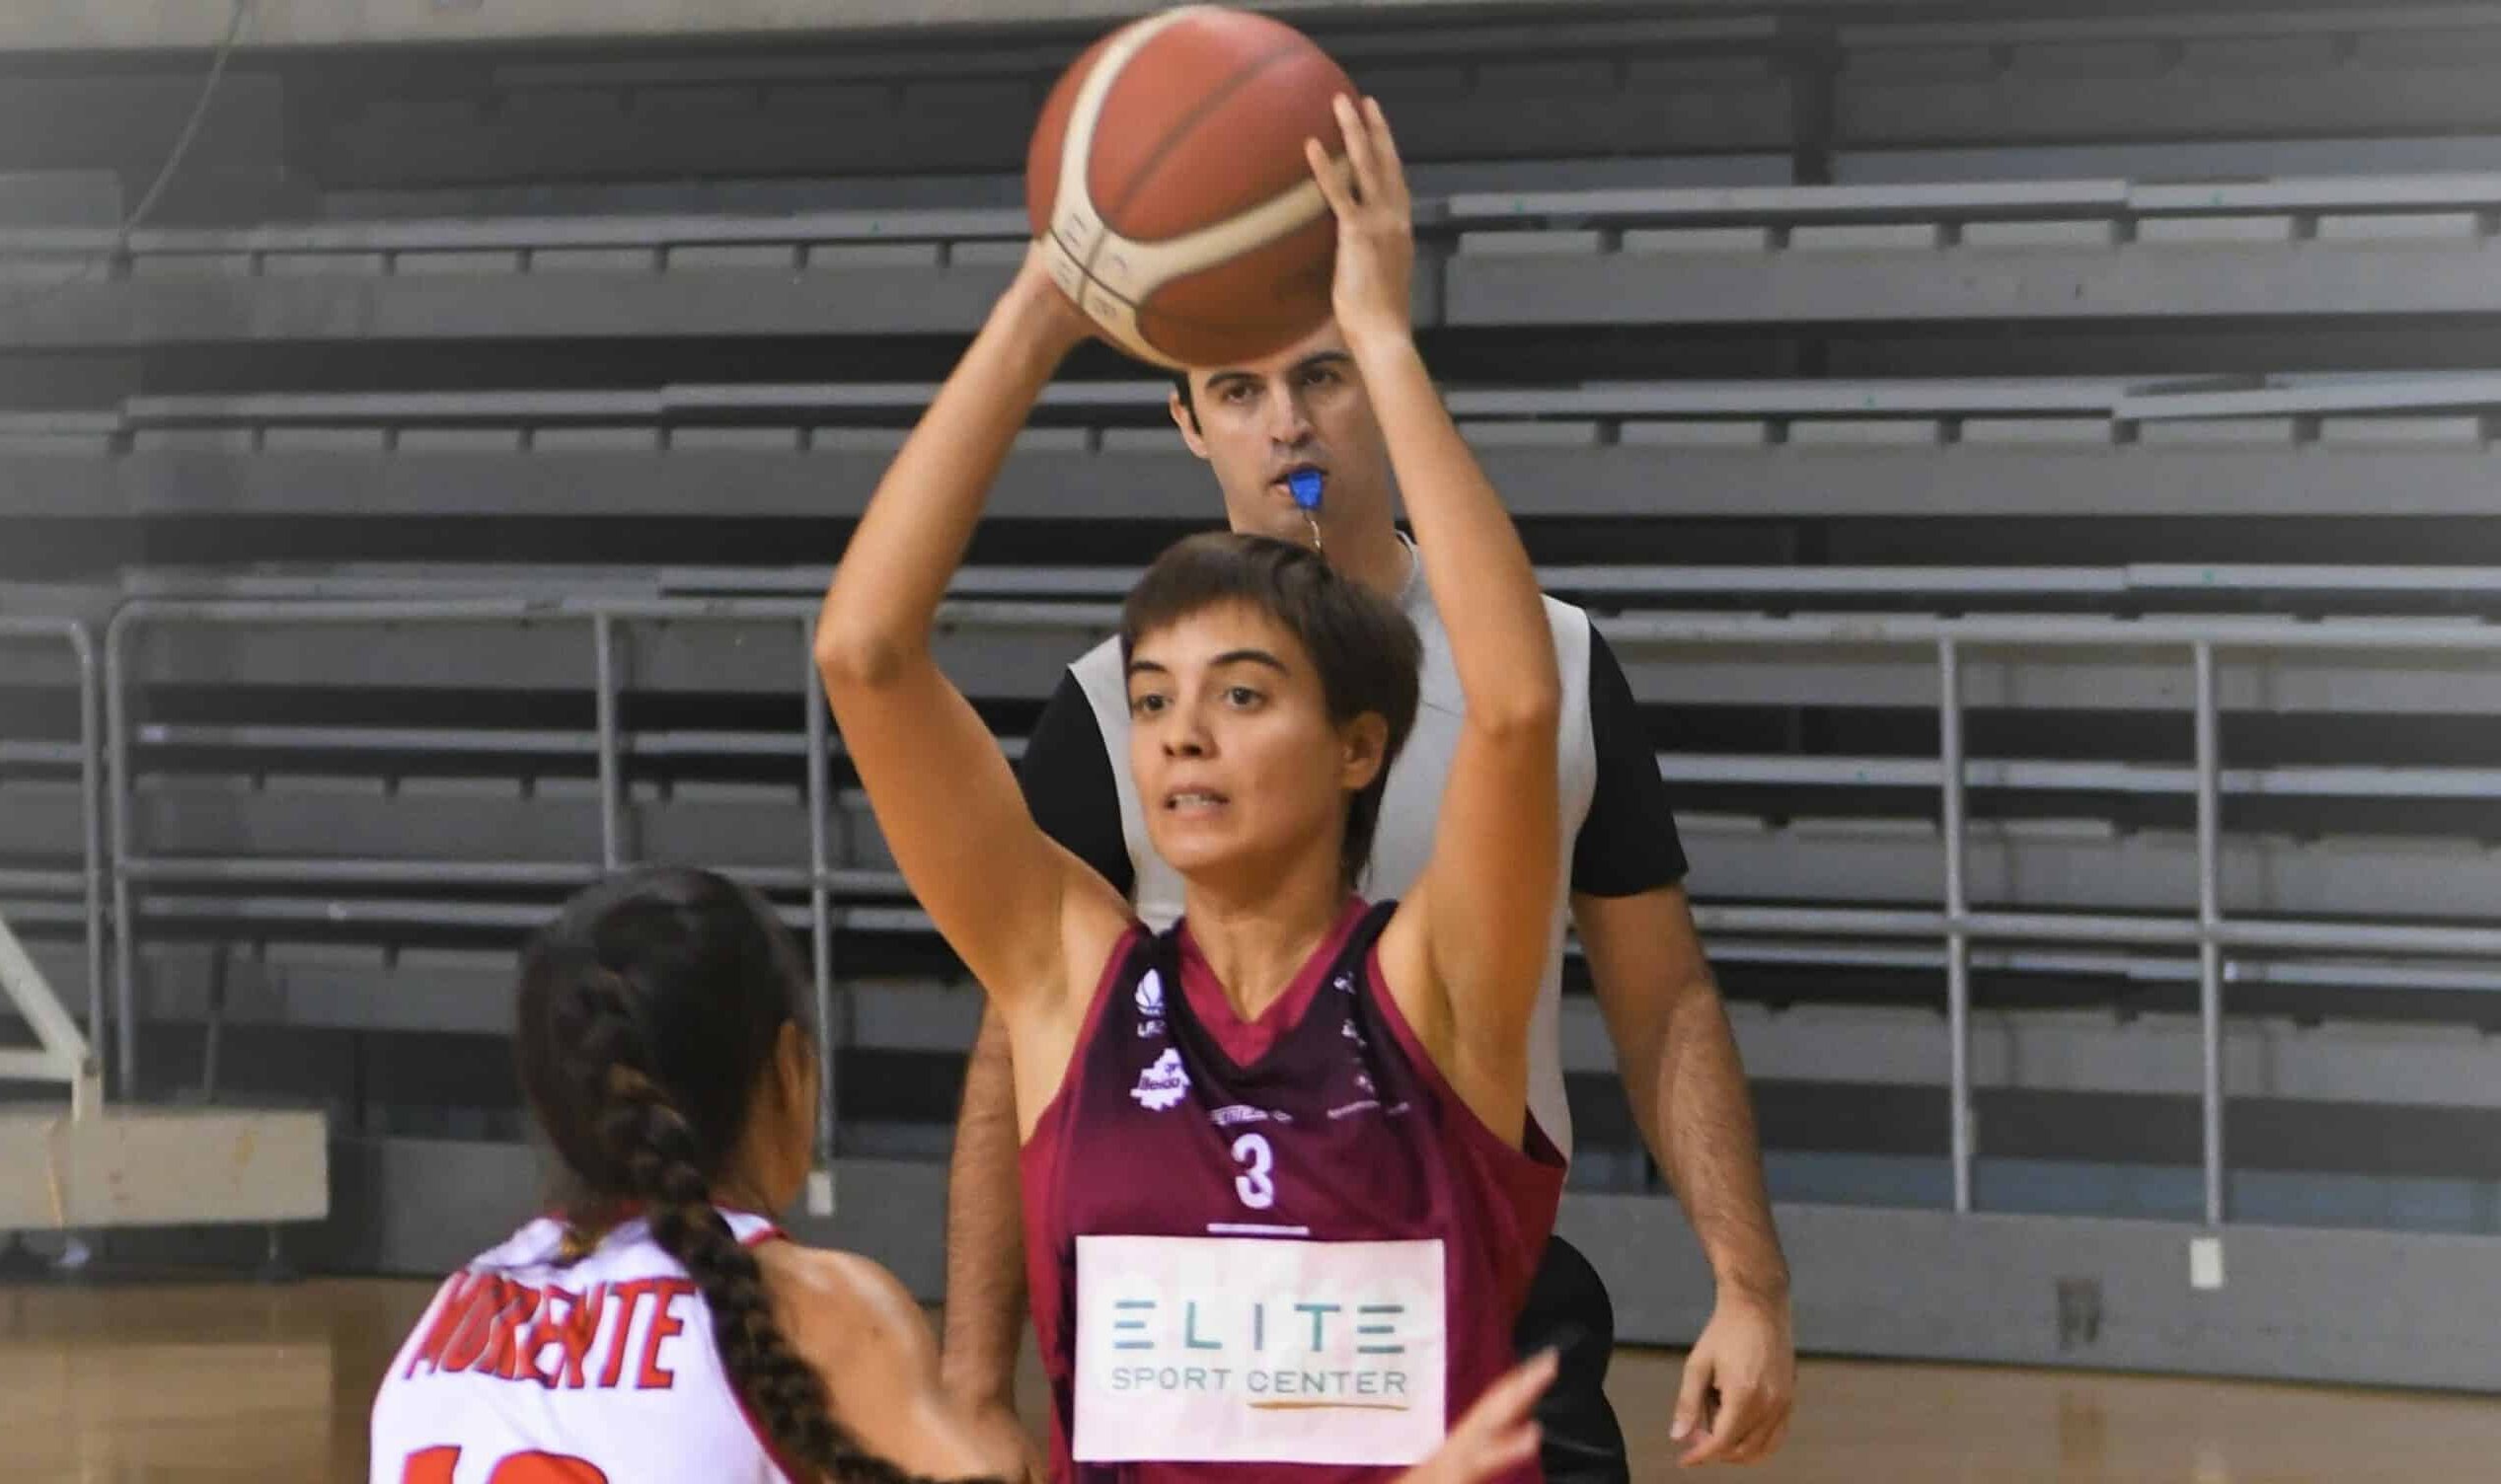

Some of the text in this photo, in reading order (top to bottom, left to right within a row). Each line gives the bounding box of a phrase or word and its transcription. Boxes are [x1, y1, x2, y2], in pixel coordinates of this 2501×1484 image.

[1231, 1133, 1274, 1210] 3
[1112, 1299, 1405, 1355] ELITE
[1111, 1367, 1408, 1394] SPORT CENTER
